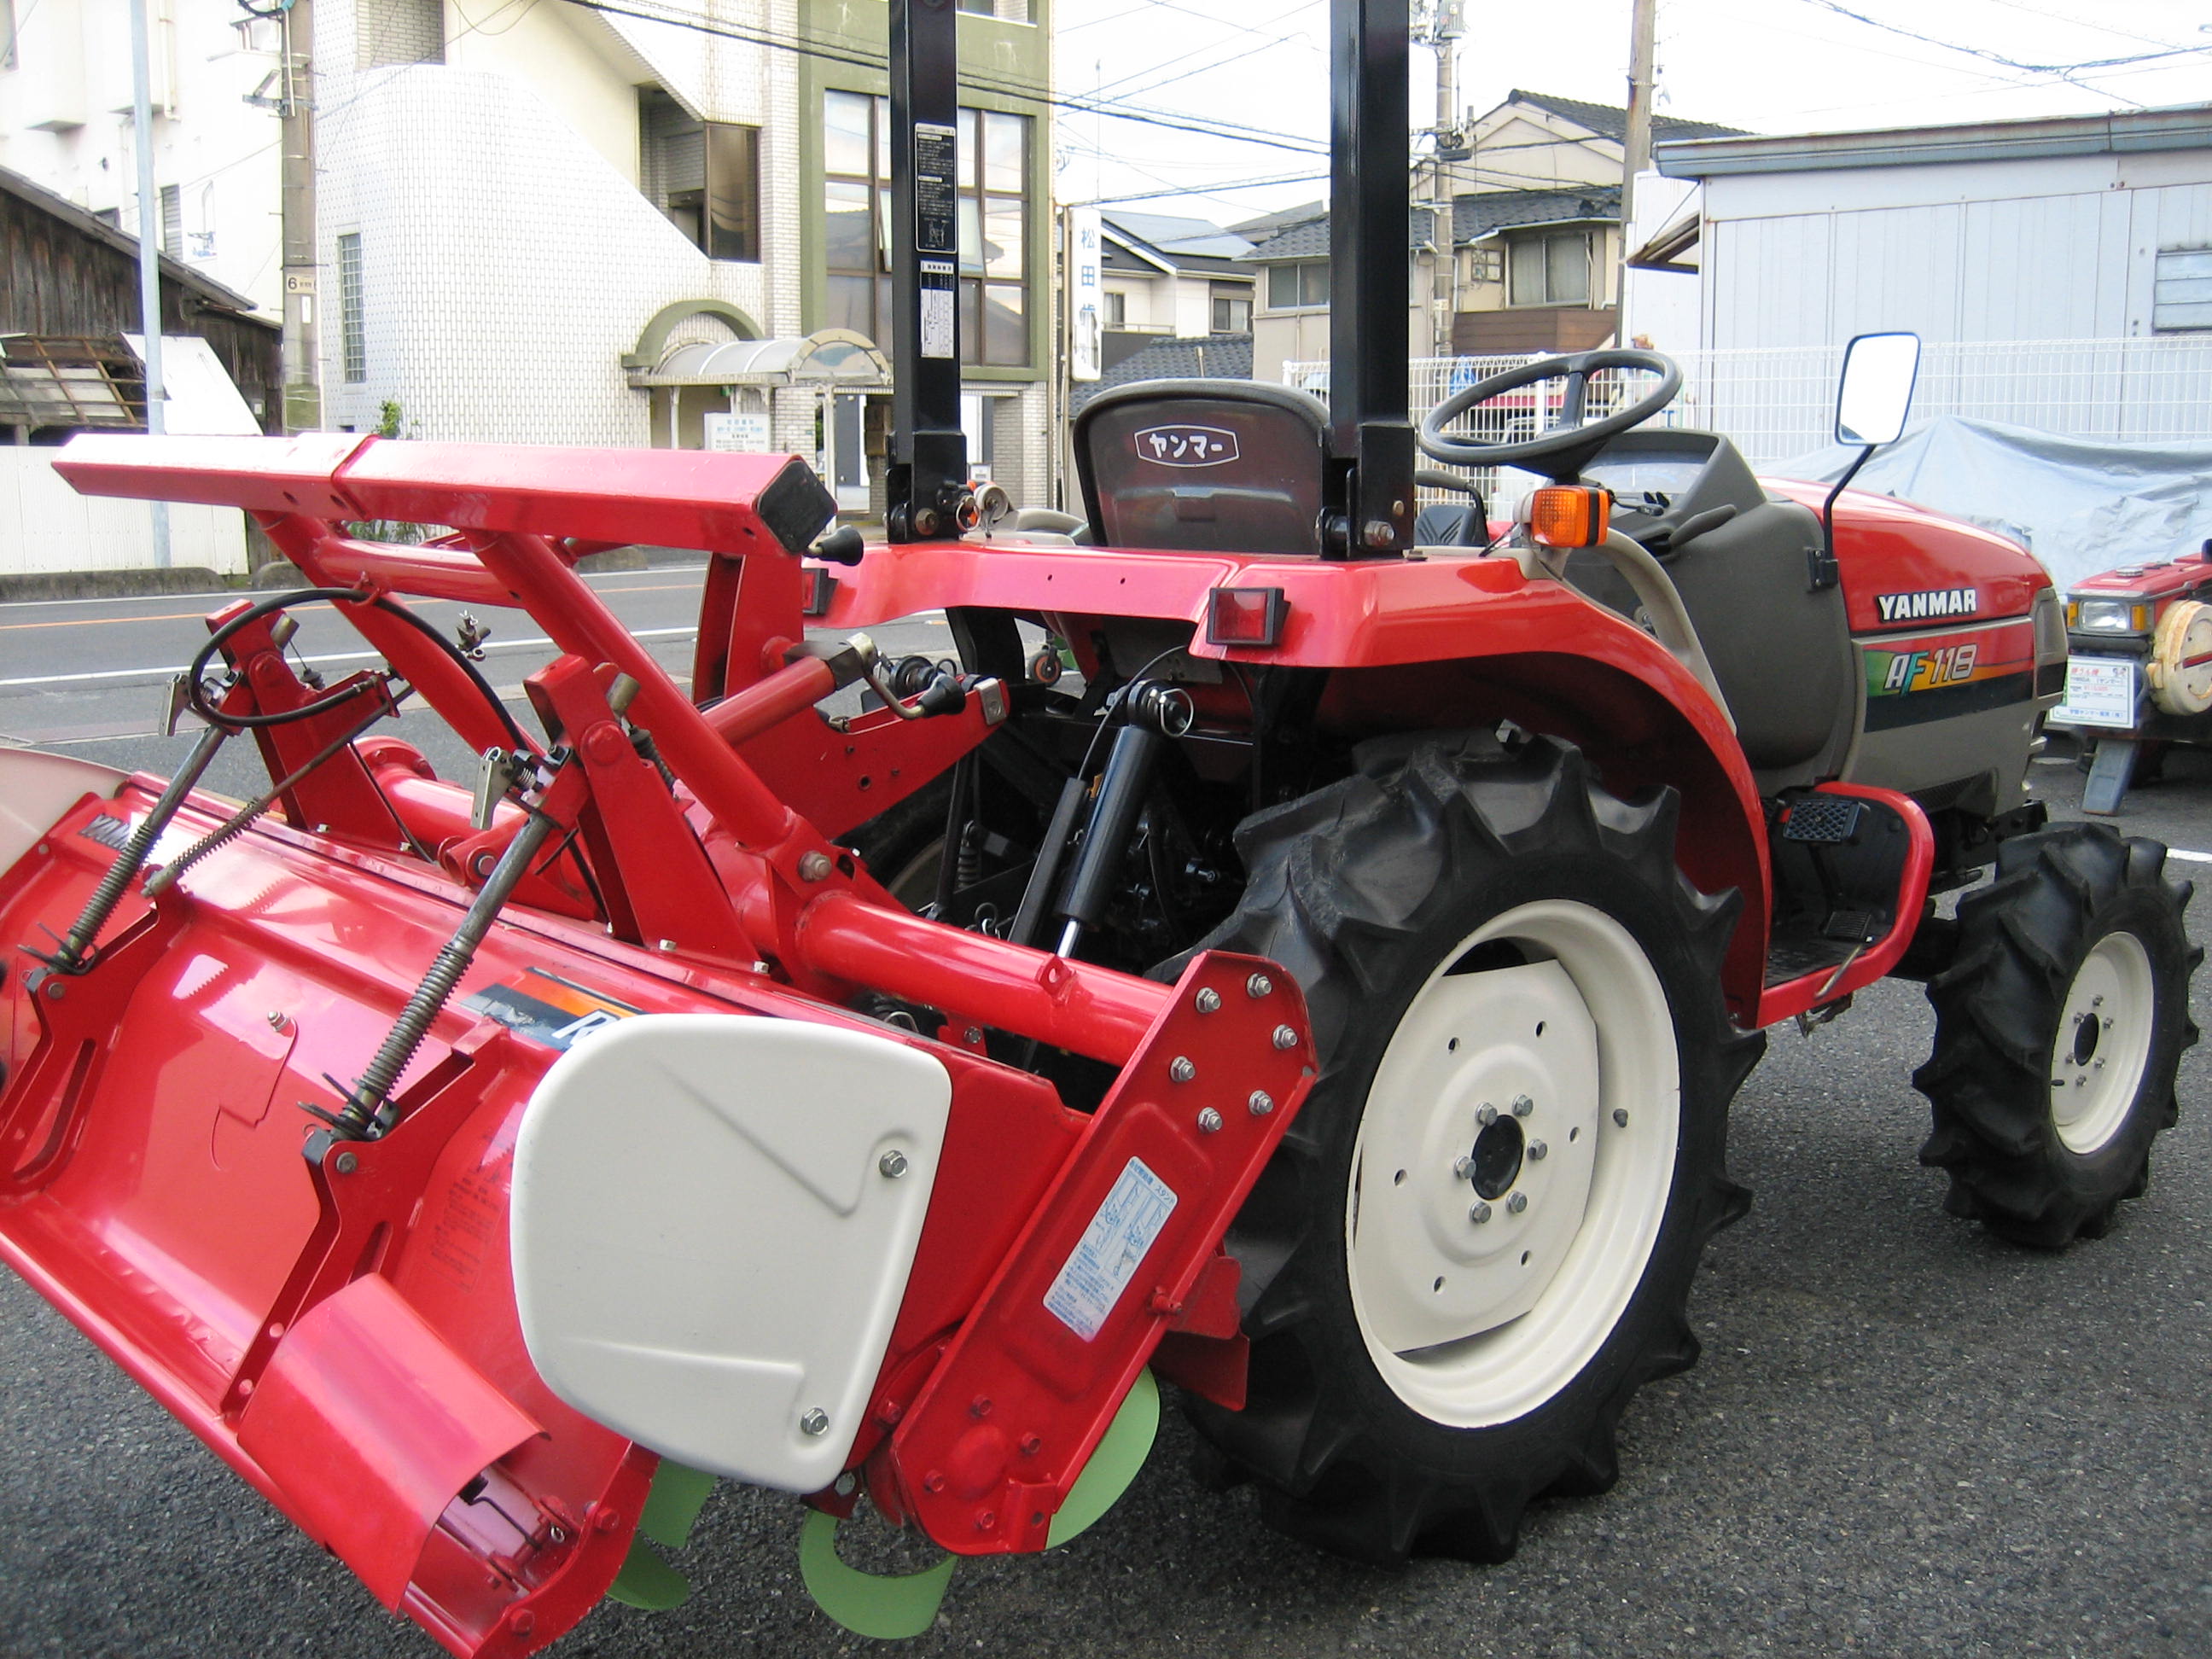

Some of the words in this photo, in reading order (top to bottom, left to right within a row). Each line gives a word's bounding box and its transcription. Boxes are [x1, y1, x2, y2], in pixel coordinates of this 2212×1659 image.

[288, 276, 298, 290] 6
[1149, 433, 1223, 459] ヤンマー
[1877, 588, 1977, 622] YANMAR
[1883, 643, 1978, 696] AF118
